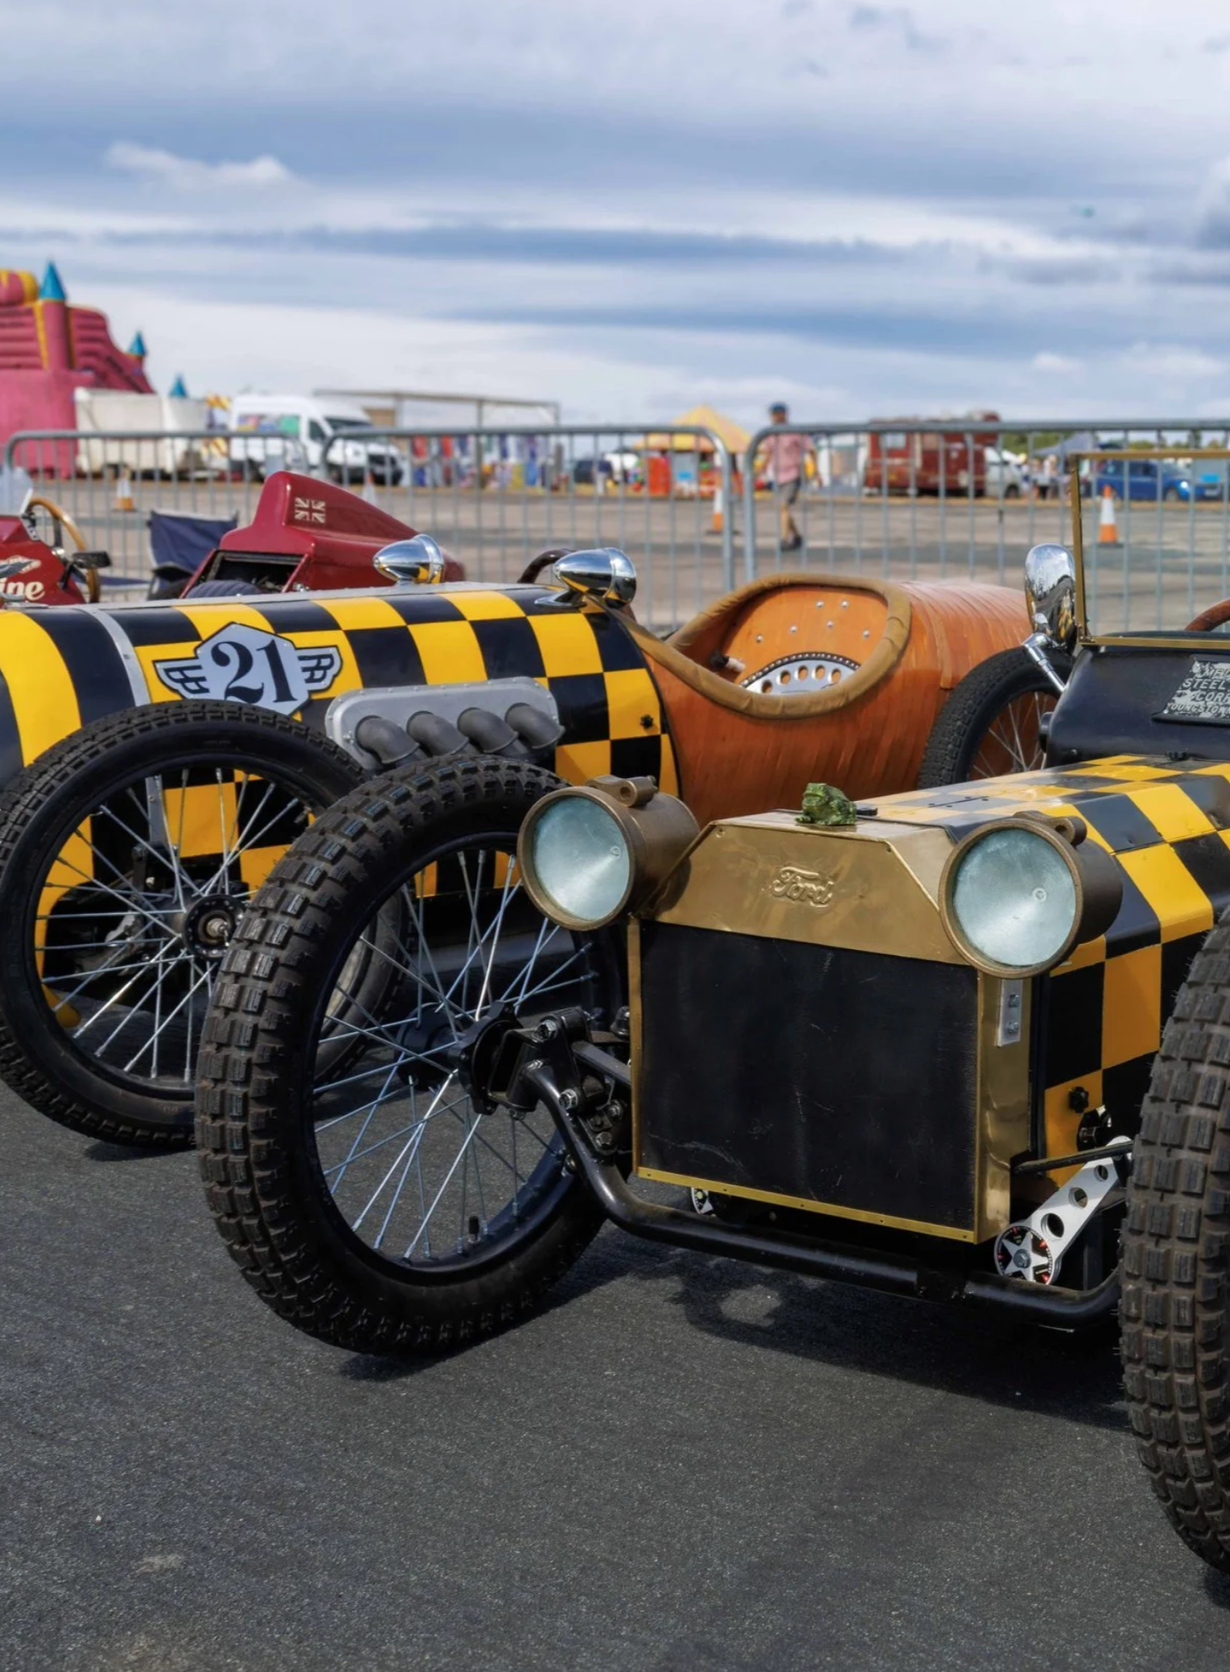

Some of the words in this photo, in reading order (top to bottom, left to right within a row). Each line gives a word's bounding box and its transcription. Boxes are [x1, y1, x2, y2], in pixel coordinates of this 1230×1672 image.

[211, 639, 297, 704] 21
[1182, 678, 1226, 690] STEEL
[772, 866, 835, 908] Ford
